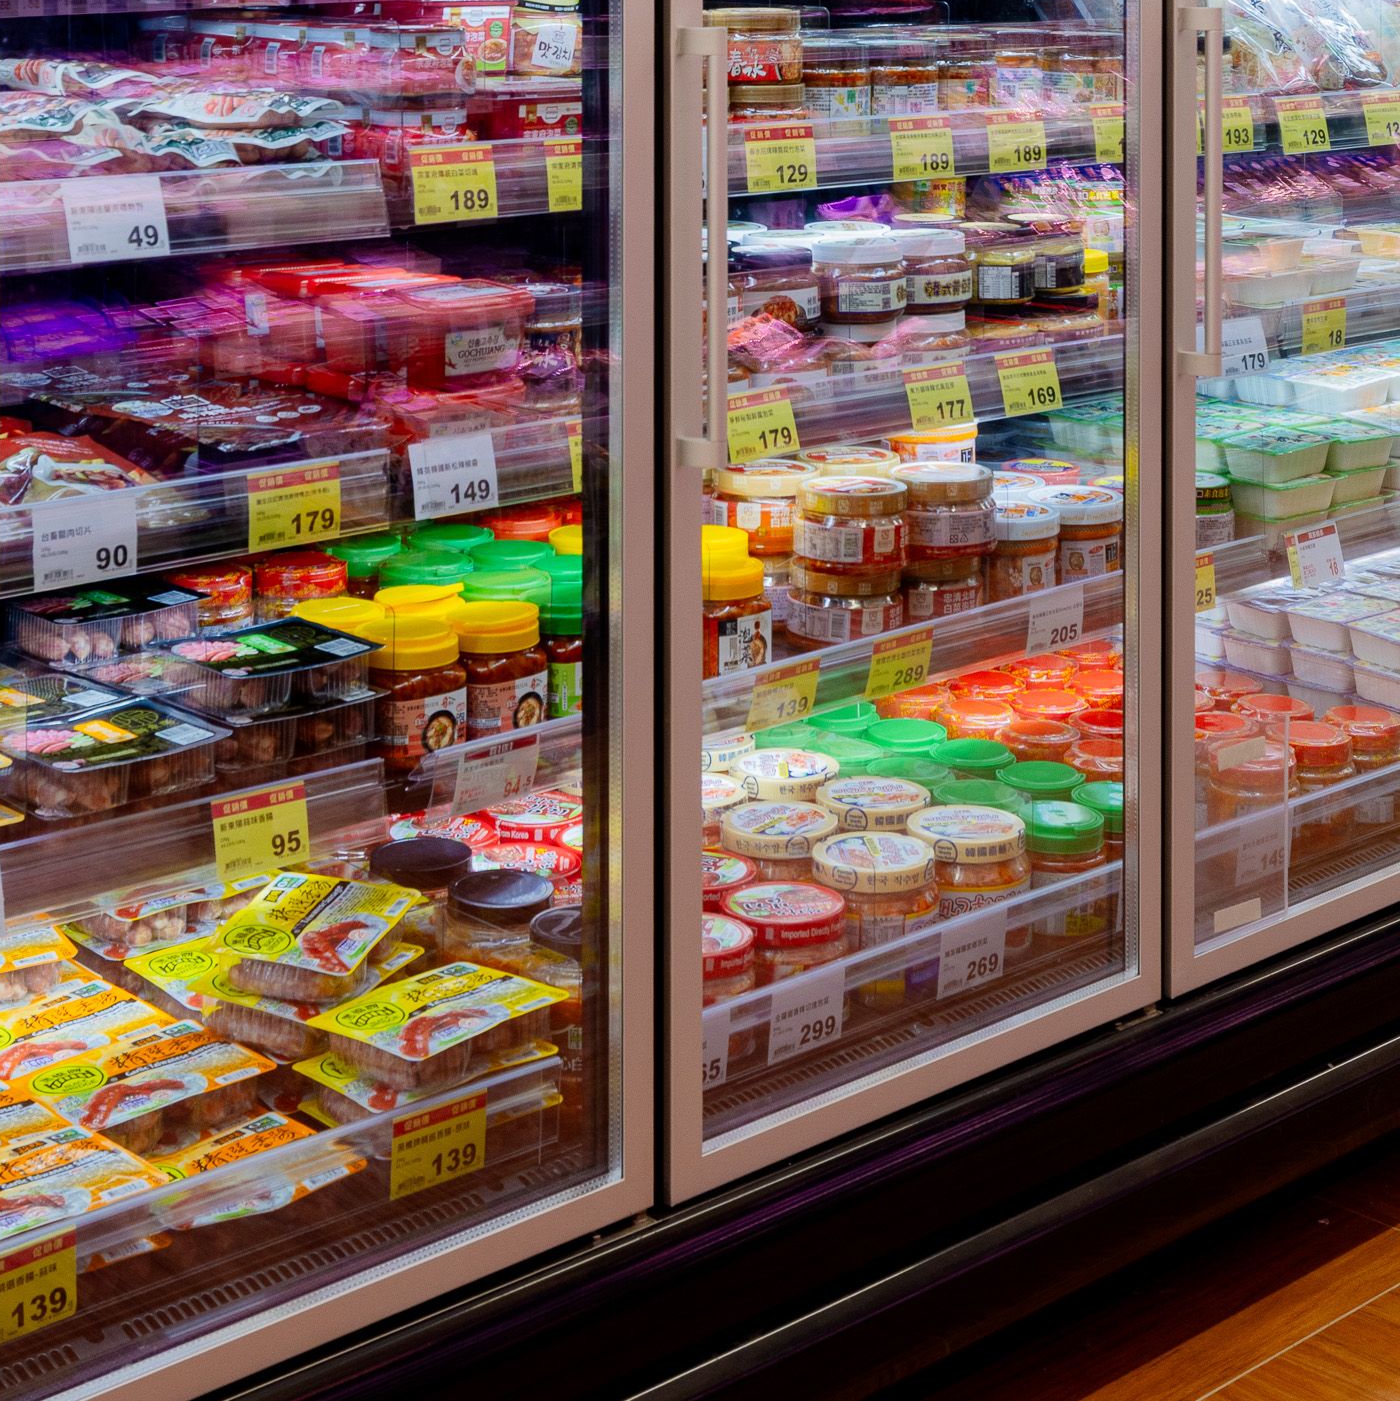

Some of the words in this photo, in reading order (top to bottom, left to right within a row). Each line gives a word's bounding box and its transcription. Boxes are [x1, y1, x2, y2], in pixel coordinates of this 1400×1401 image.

[1224, 128, 1250, 146] 193
[1302, 128, 1327, 146] 129
[920, 152, 950, 172] 189
[1013, 145, 1042, 163] 189
[775, 163, 809, 185] 129
[450, 188, 490, 212] 189
[128, 224, 160, 248] 49
[1328, 329, 1342, 345] 18
[1241, 353, 1267, 371] 179
[1027, 386, 1057, 407] 169
[936, 399, 966, 420] 177
[758, 426, 793, 450] 179
[450, 479, 490, 504] 149
[291, 507, 335, 536] 179
[95, 543, 129, 571] 90
[1049, 623, 1078, 646] 205
[893, 664, 924, 688] 289
[775, 695, 808, 719] 139
[271, 829, 302, 857] 95
[780, 929, 810, 942] Imported
[966, 953, 999, 980] 269
[799, 1016, 837, 1045] 299
[431, 1142, 477, 1177] 139
[11, 1287, 68, 1328] 139
